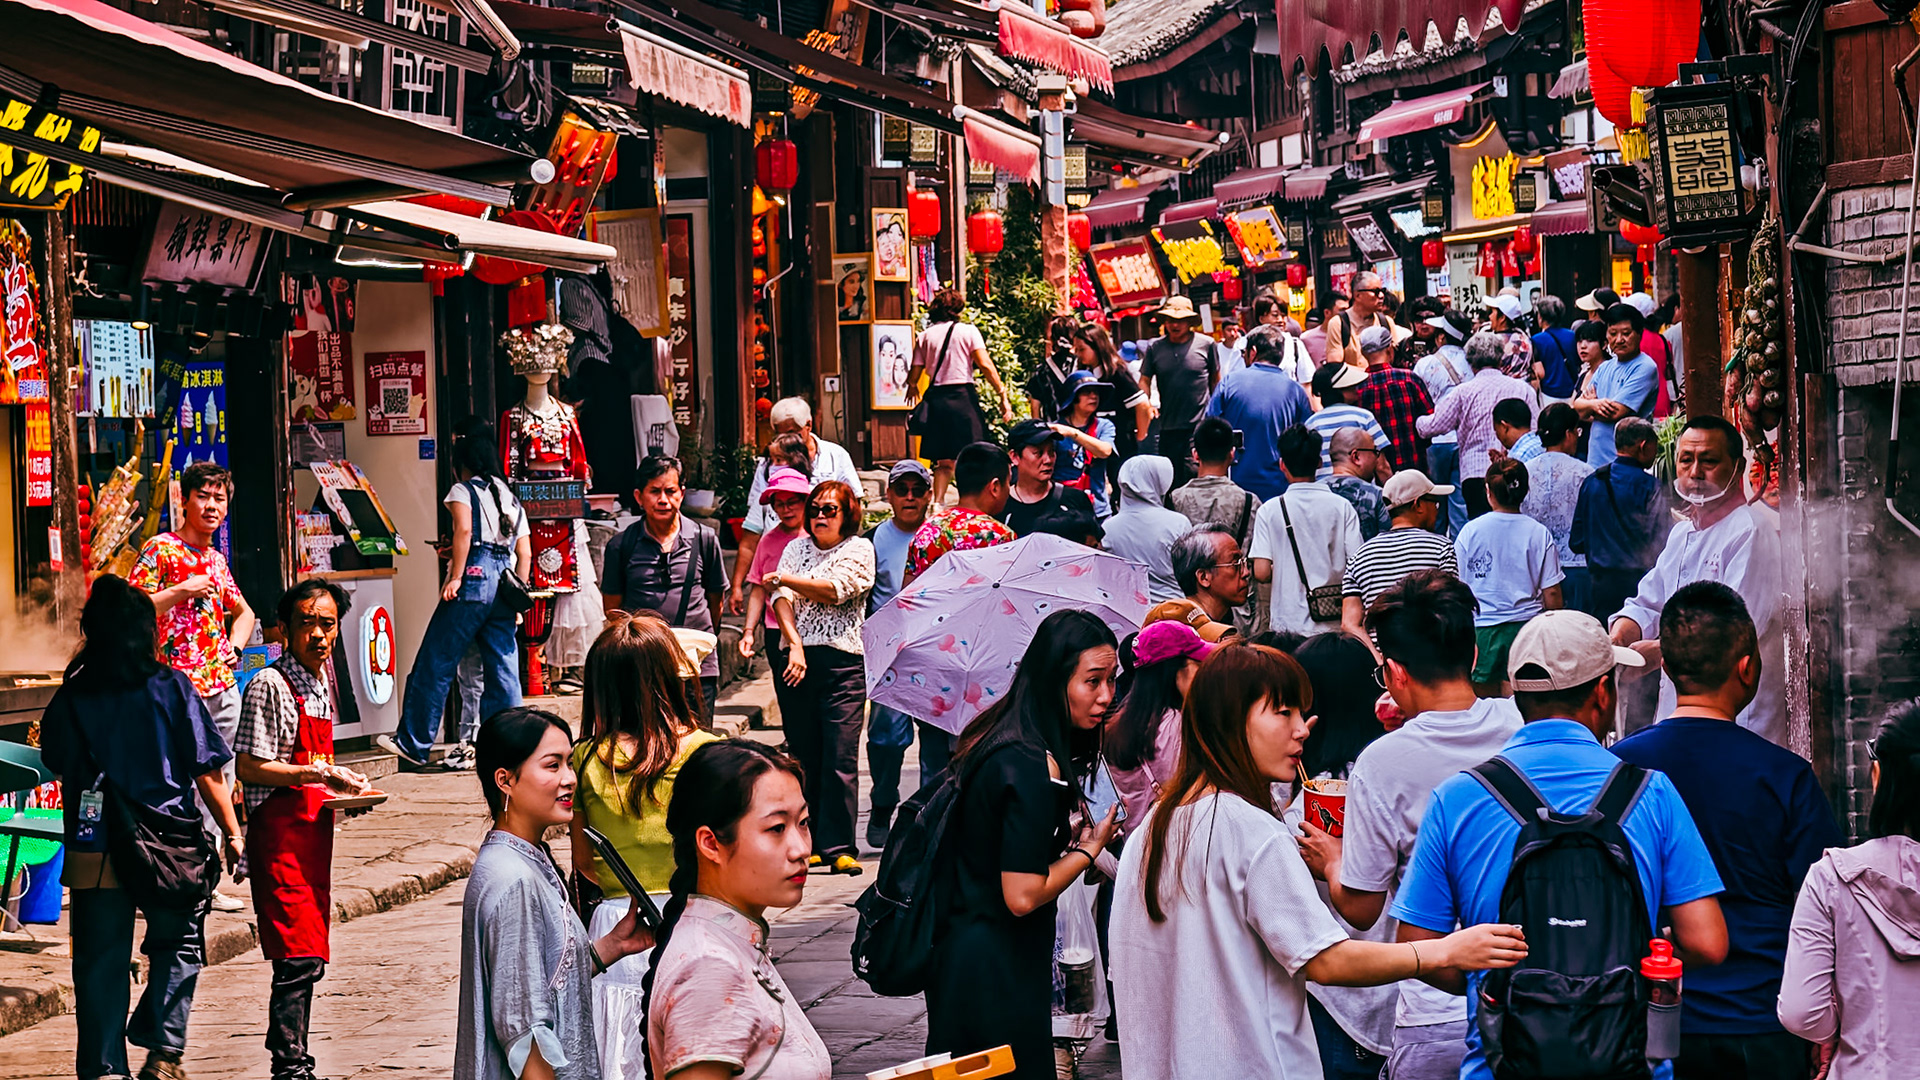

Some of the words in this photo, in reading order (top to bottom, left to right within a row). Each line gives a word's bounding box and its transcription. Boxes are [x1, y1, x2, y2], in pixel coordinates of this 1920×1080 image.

[369, 362, 424, 378] 扫码点餐
[519, 484, 582, 500] 服装出租
